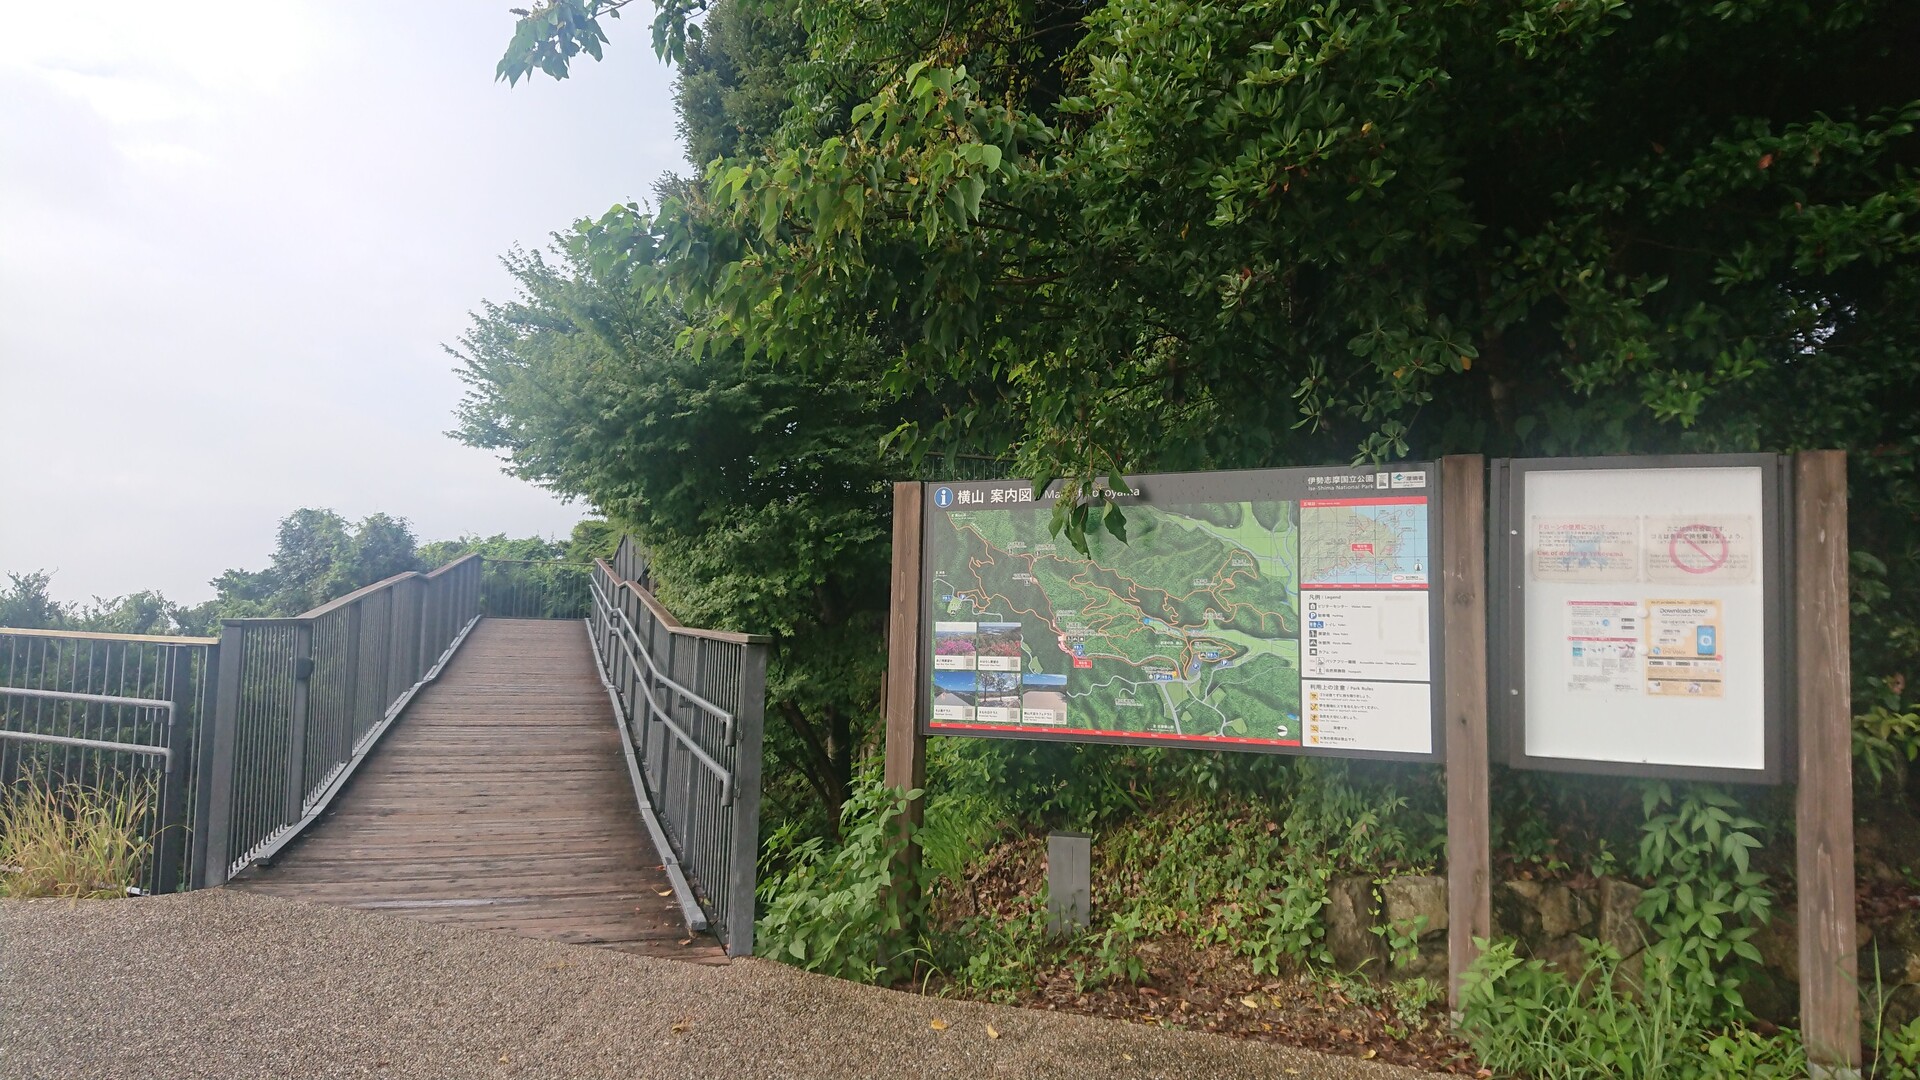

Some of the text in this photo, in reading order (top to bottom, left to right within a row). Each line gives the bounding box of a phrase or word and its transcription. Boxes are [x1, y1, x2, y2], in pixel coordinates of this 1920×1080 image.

[1307, 474, 1374, 485] 伊勢志摩国立公園
[957, 487, 1032, 505] 横山 案内図
